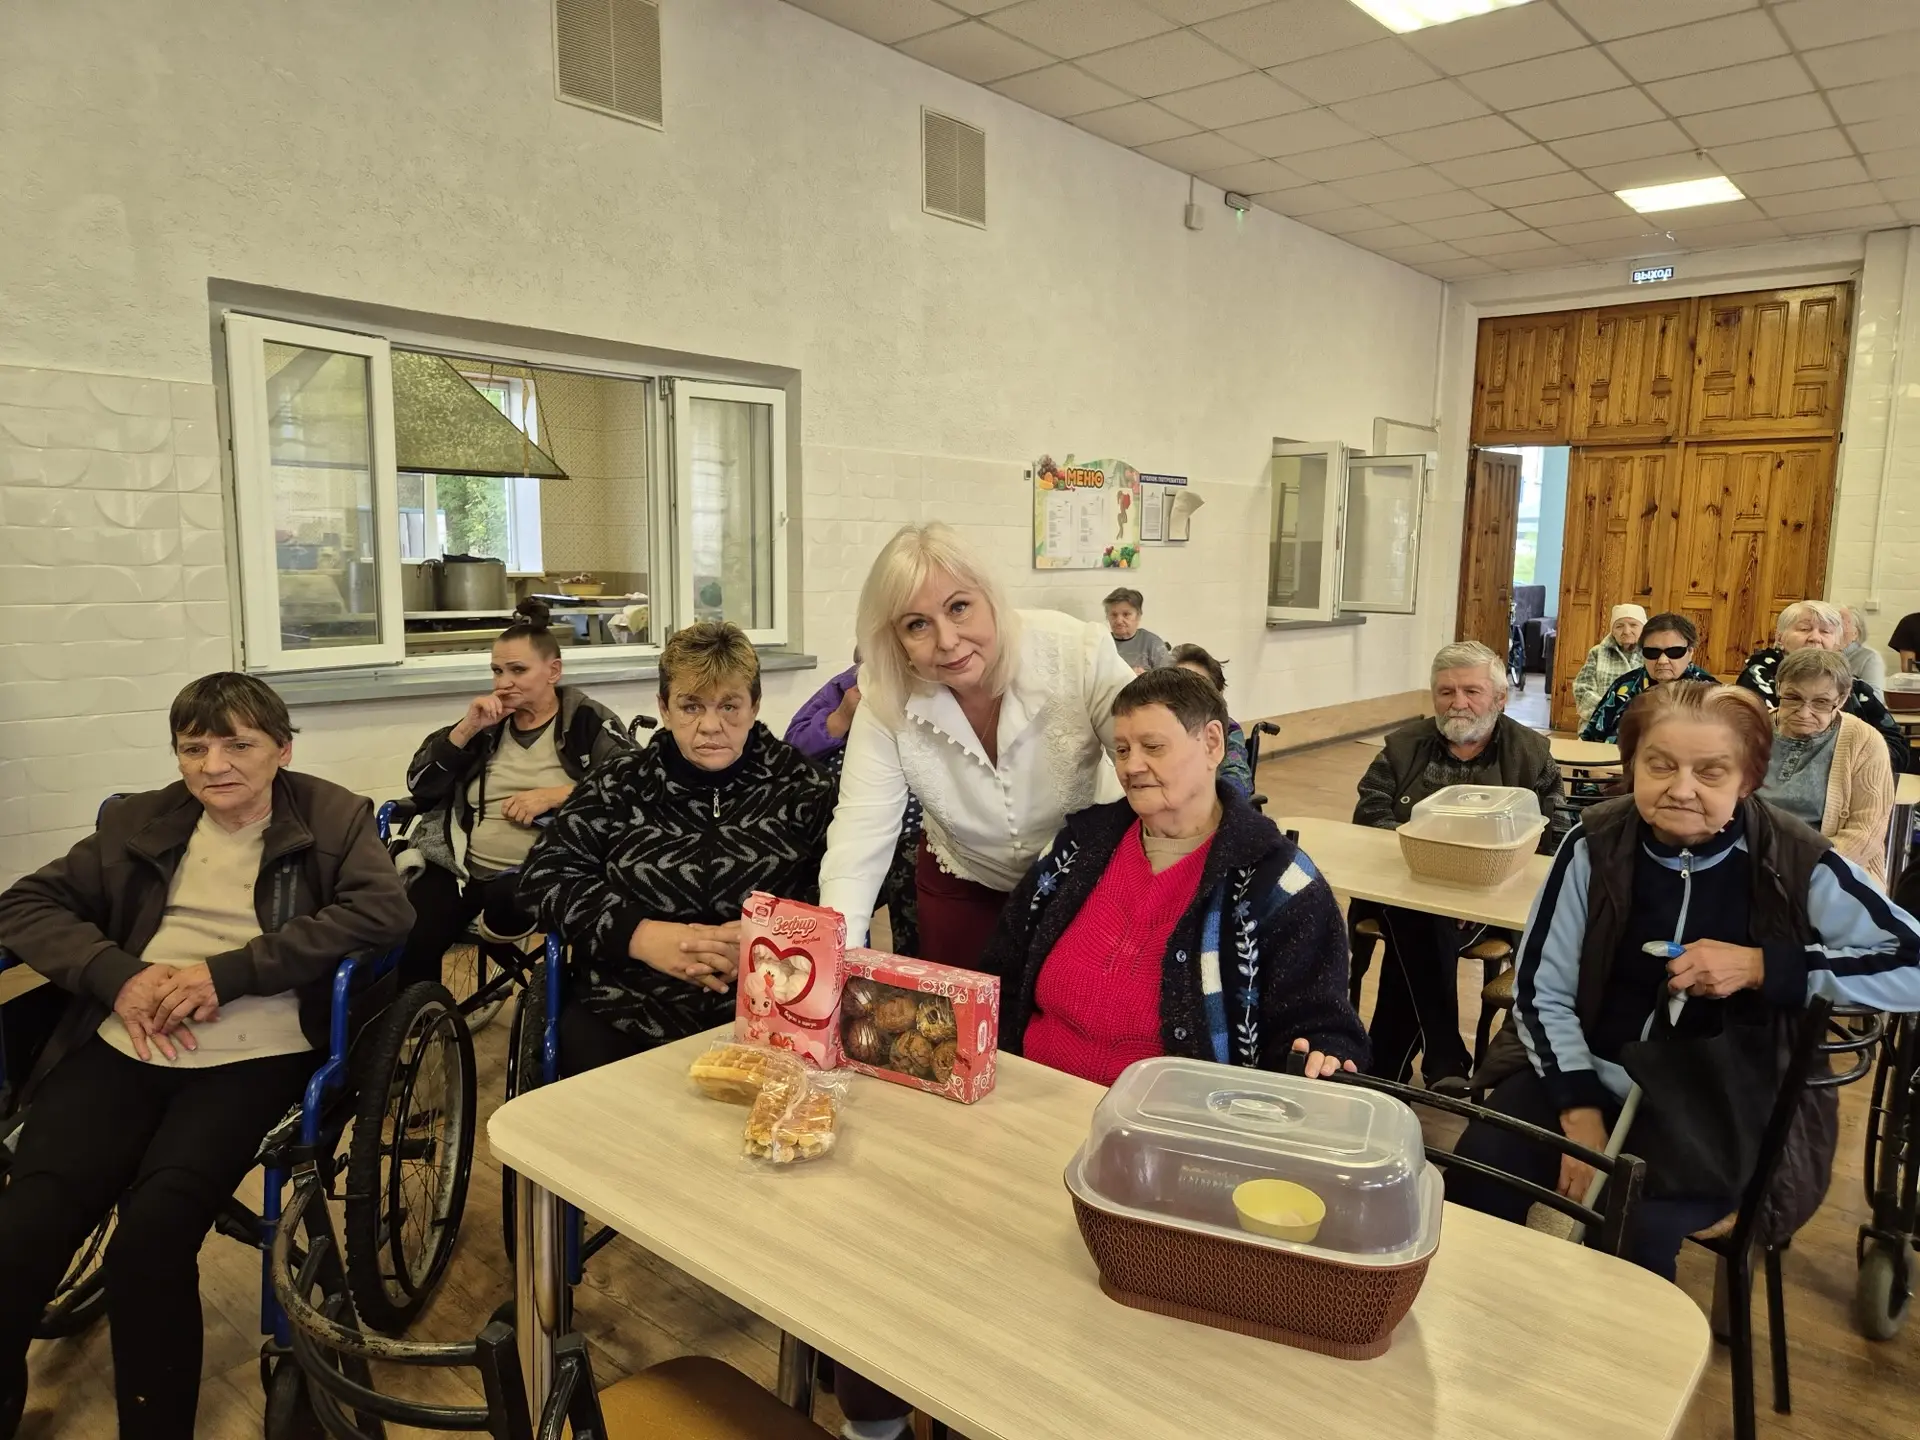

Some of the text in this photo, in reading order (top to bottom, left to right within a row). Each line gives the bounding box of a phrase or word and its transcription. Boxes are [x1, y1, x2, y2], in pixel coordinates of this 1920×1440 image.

[1633, 268, 1672, 281] ВЫХОД
[1066, 467, 1105, 489] МЕНЮ
[772, 915, 817, 938] Зефир
